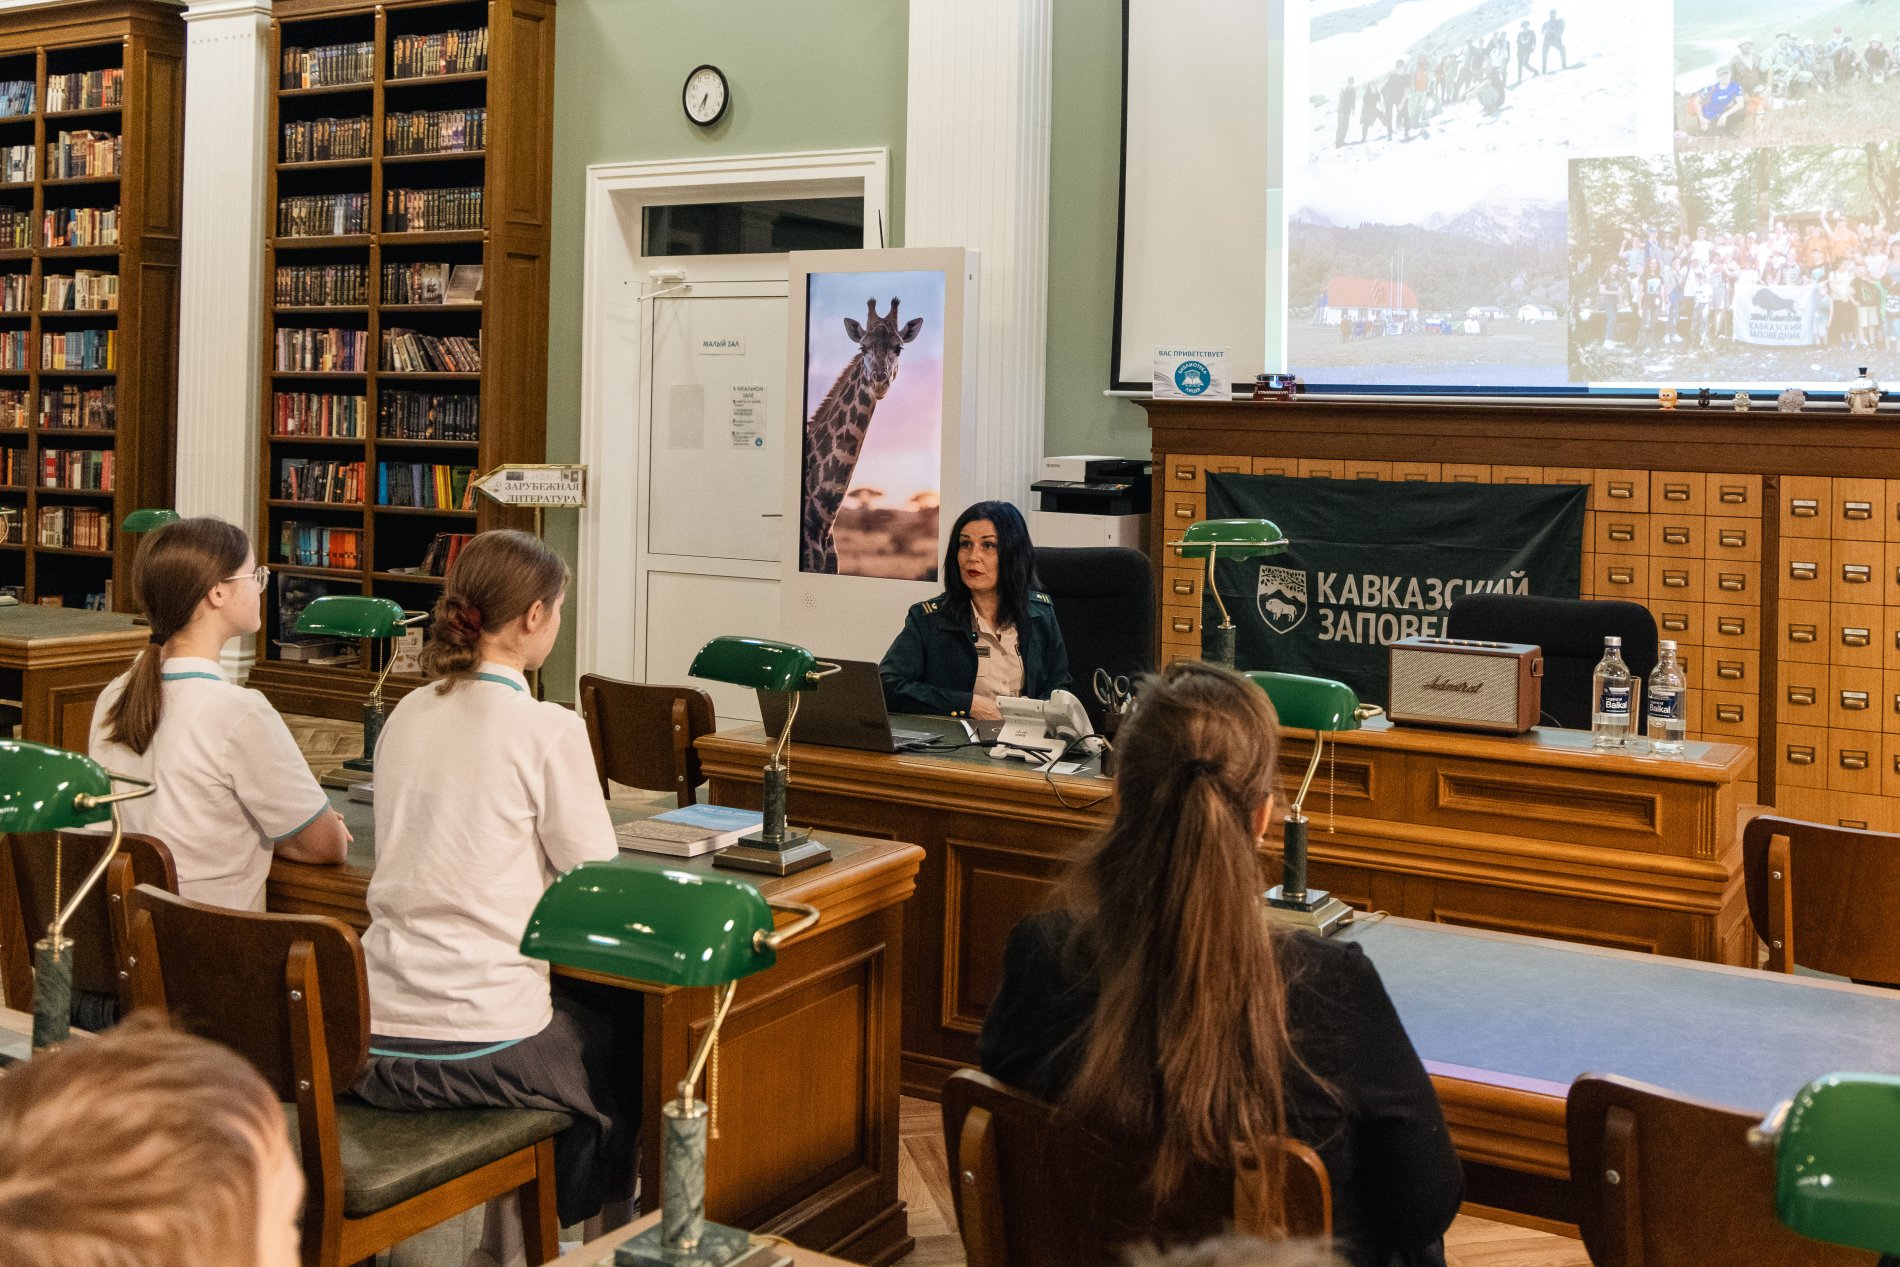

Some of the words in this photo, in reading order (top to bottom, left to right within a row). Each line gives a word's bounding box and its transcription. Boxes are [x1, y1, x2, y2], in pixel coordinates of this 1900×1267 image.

[1749, 322, 1802, 332] КАВКАЗСКИЙ
[1749, 331, 1800, 339] ЗАПОВЕДНИК
[702, 340, 726, 348] МАЛЫЙ
[1178, 362, 1208, 374] БИБЛИОТЕКА
[504, 481, 579, 491] ЗАРУБЕЖНАЯ
[506, 494, 577, 503] ЛИТЕРАТУРА
[1318, 608, 1448, 646] ЗАПОВЕ
[1650, 704, 1671, 713] Baikal
